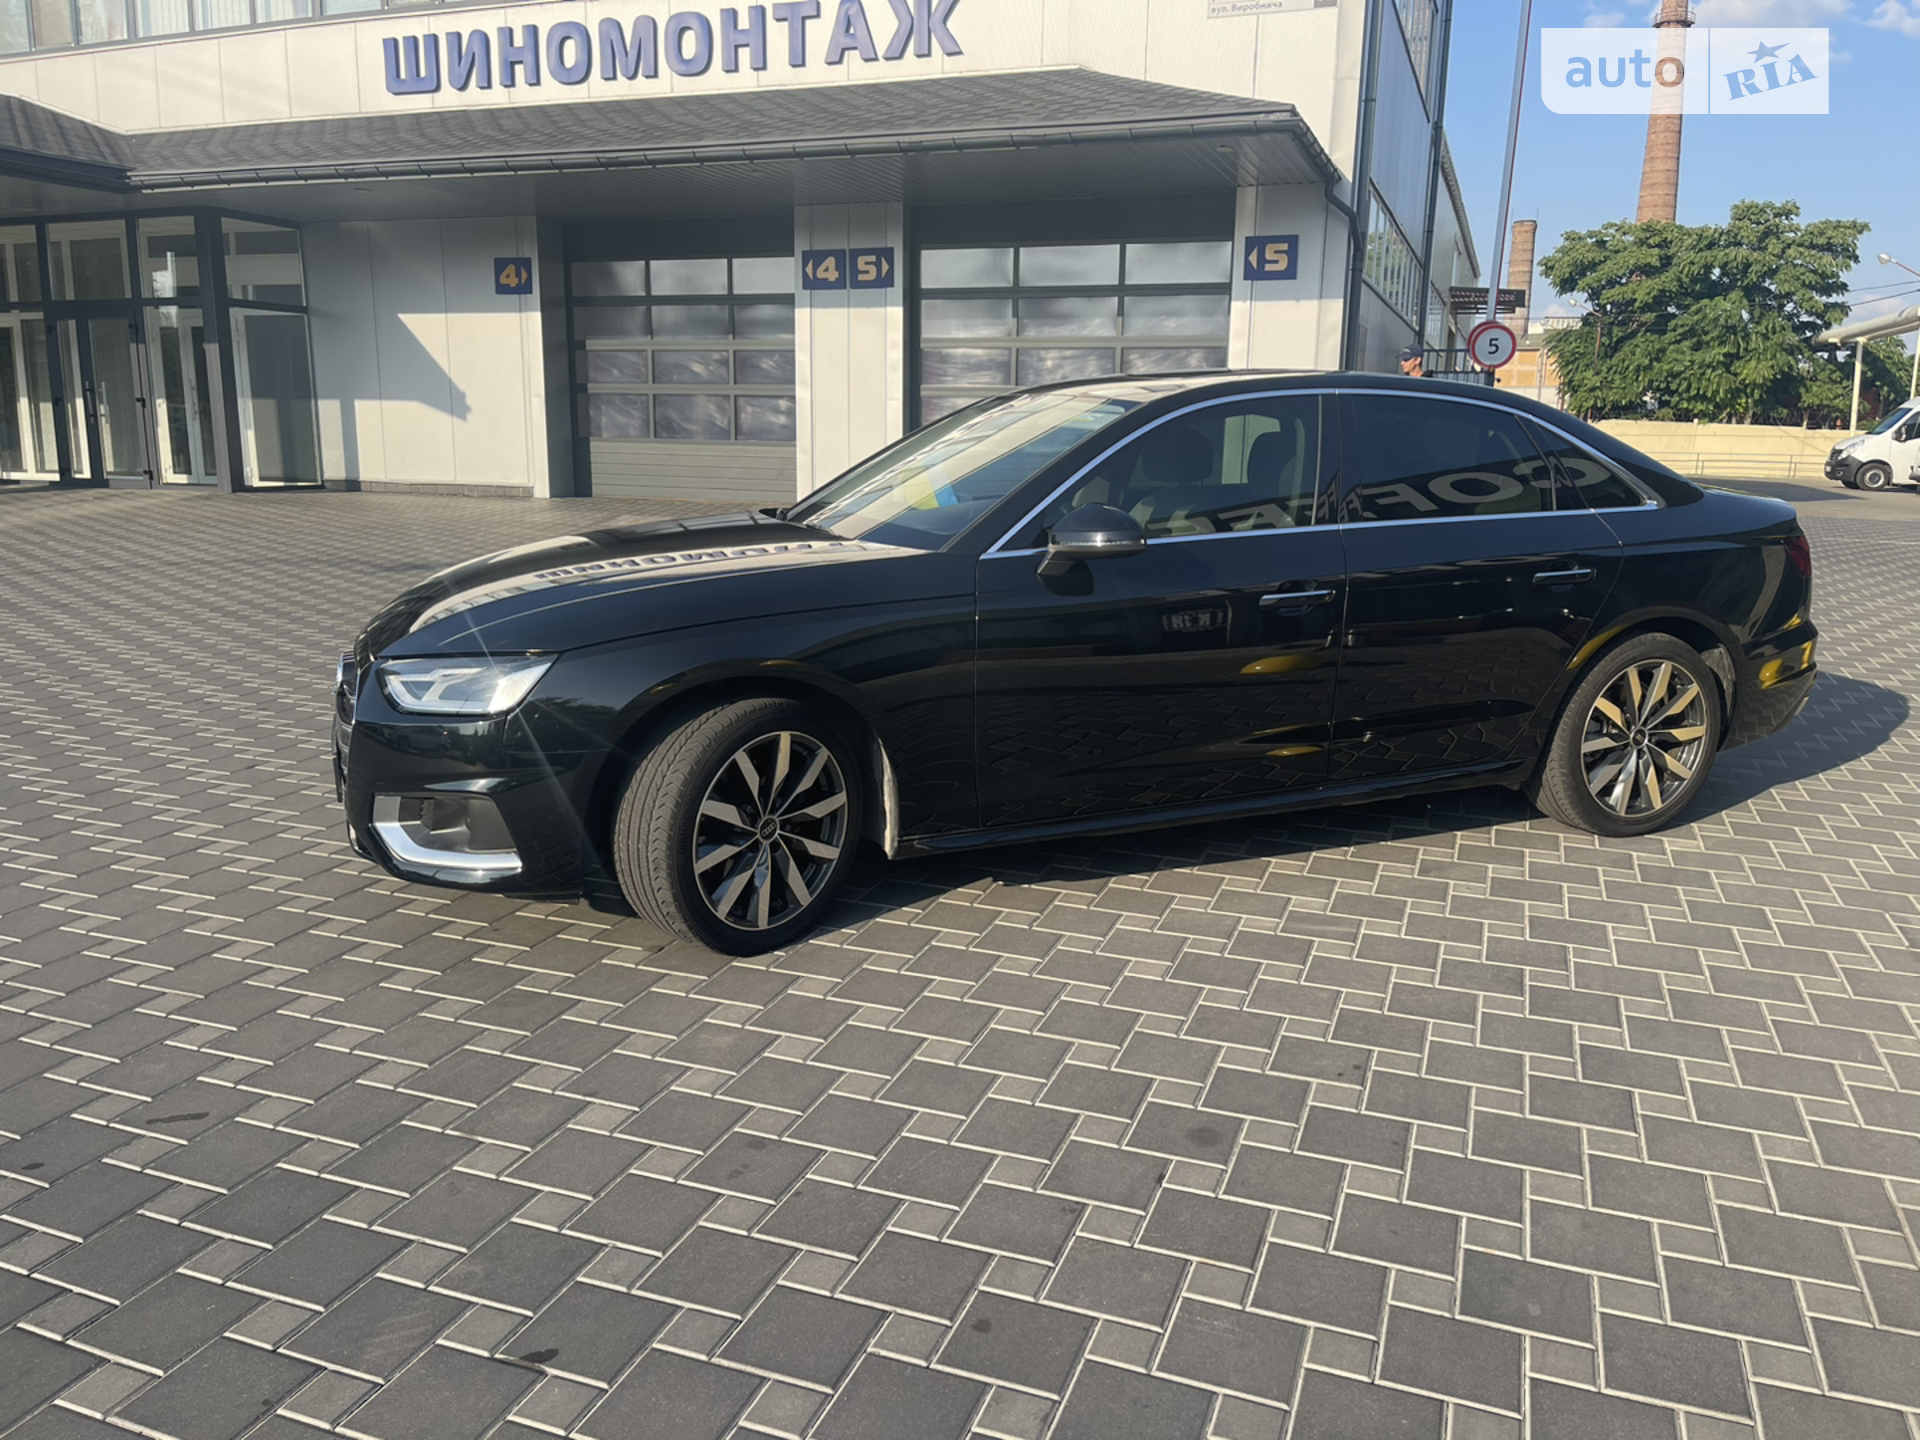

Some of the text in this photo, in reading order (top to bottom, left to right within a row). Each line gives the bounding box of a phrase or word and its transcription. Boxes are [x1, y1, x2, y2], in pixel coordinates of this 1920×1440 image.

[382, 0, 963, 95] ШИНОМОНТАЖ
[816, 256, 839, 282] 4
[857, 255, 877, 281] 5
[1264, 243, 1288, 271] 5
[499, 264, 518, 287] 4
[1488, 338, 1499, 354] 5
